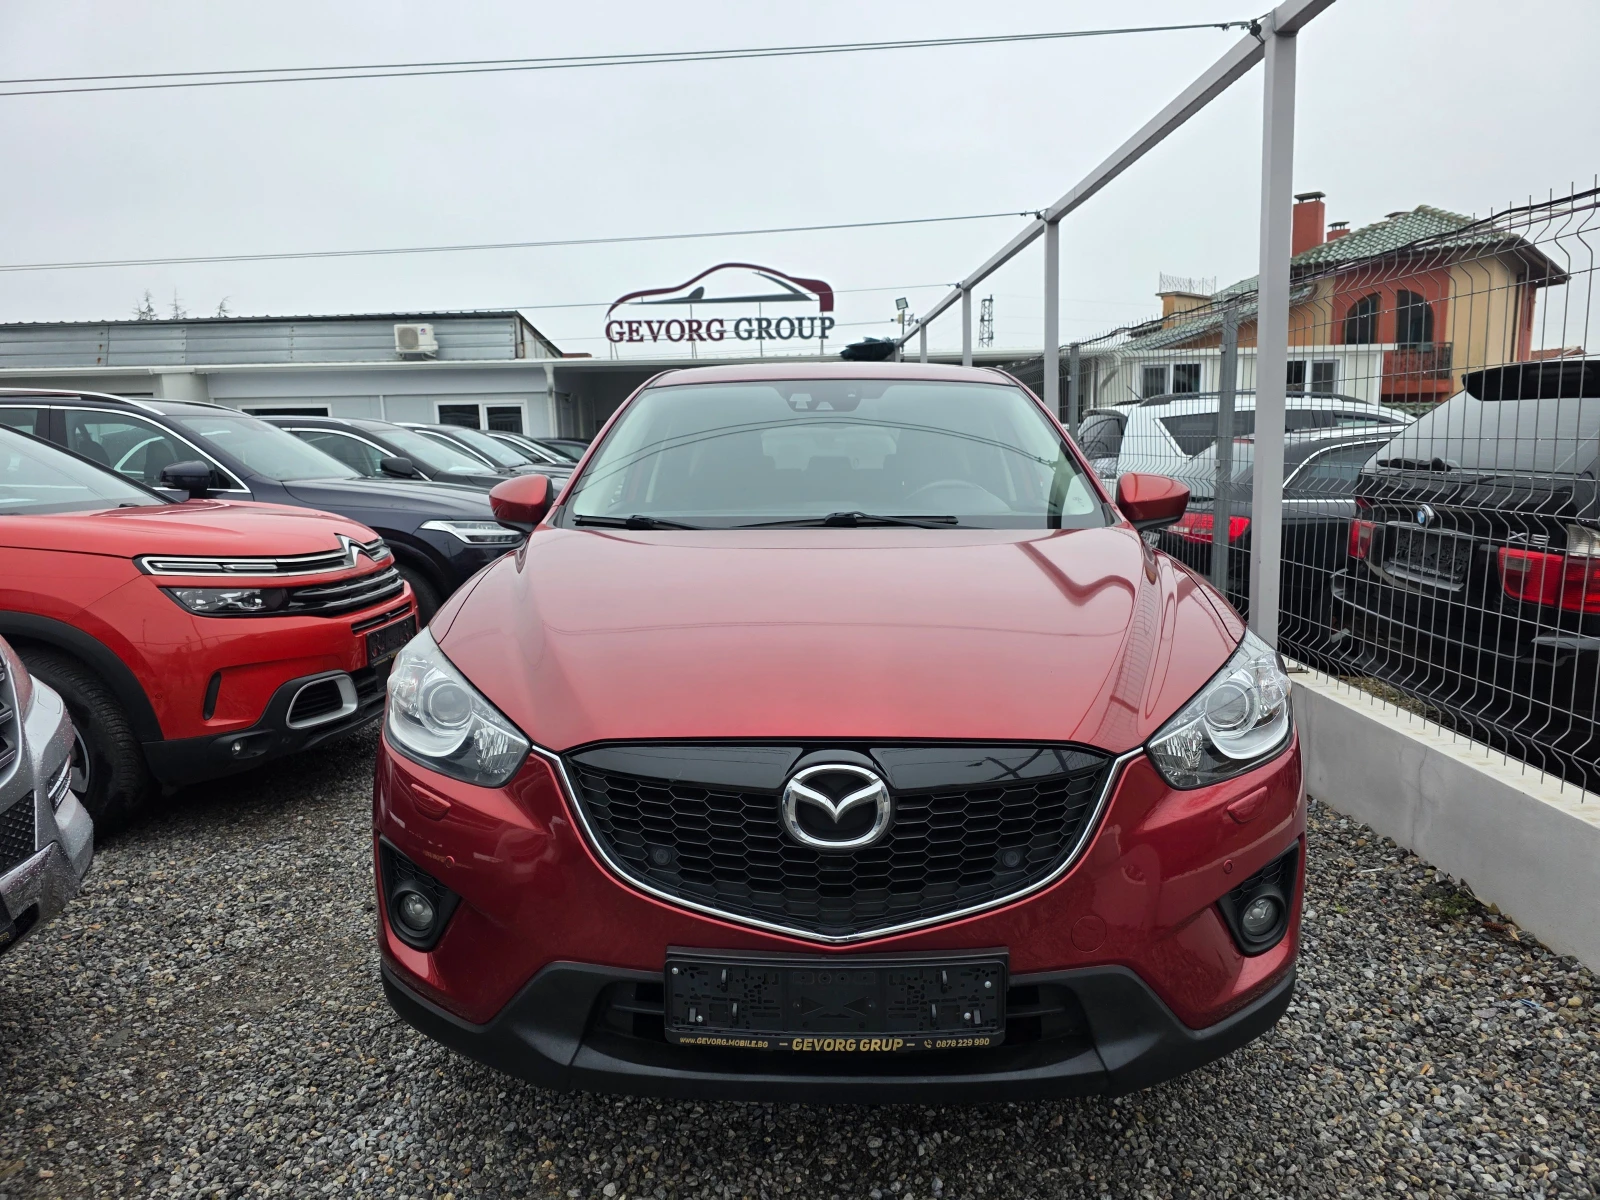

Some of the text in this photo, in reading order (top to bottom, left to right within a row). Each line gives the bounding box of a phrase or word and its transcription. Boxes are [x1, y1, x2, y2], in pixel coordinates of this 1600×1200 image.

[605, 316, 836, 343] GEVORG GROUP
[791, 1037, 904, 1052] GEVORG GRUP
[935, 1037, 990, 1048] 0878 229 990
